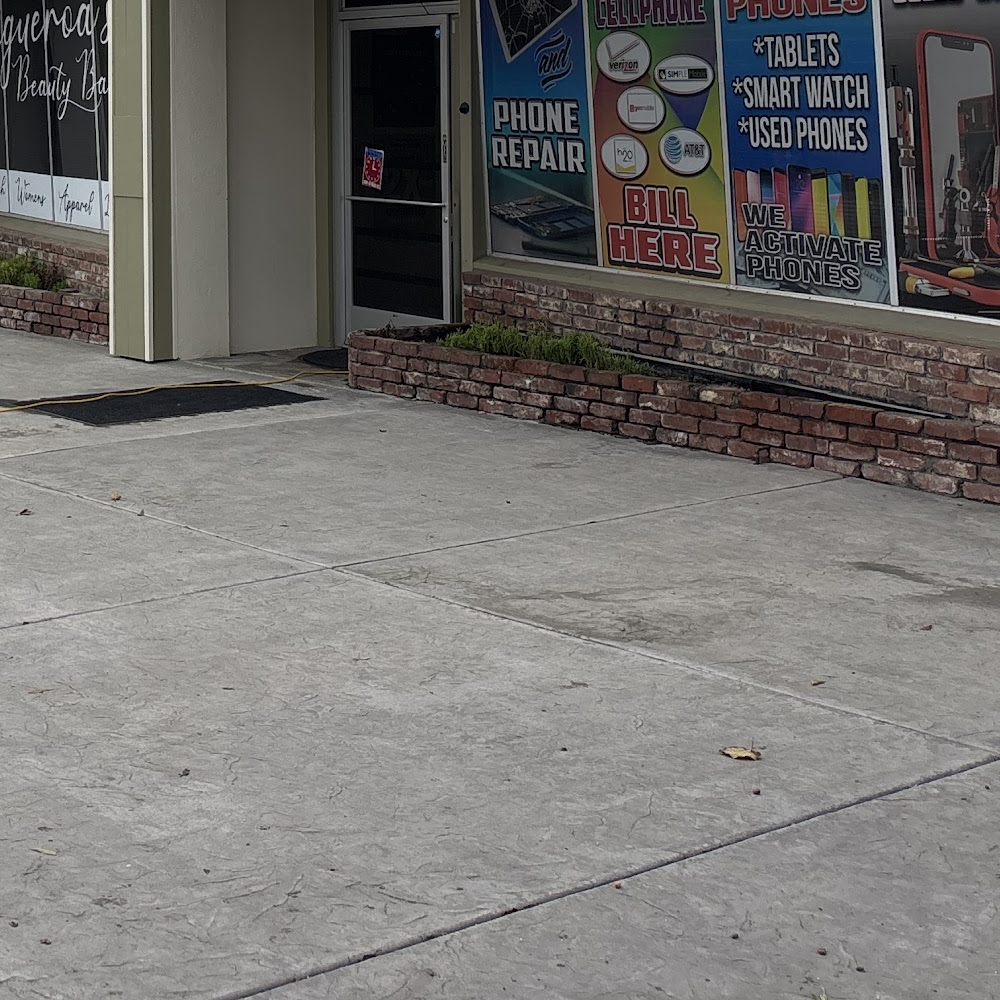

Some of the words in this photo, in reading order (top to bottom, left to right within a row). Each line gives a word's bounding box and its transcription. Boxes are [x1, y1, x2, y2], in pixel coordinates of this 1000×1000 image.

[538, 35, 572, 75] and
[609, 59, 638, 72] verizon
[11, 54, 92, 120] Beauty
[805, 74, 870, 109] WATCH
[493, 99, 580, 133] PHONE
[796, 117, 868, 151] PHONES
[491, 135, 587, 174] REPAIR
[684, 143, 705, 156] AT&T
[59, 183, 95, 222] Apparel
[624, 185, 698, 230] BILL
[741, 203, 787, 229] WE
[608, 224, 721, 275] HERE
[744, 229, 883, 266] ACTIVATE
[746, 254, 862, 290] PHONES
